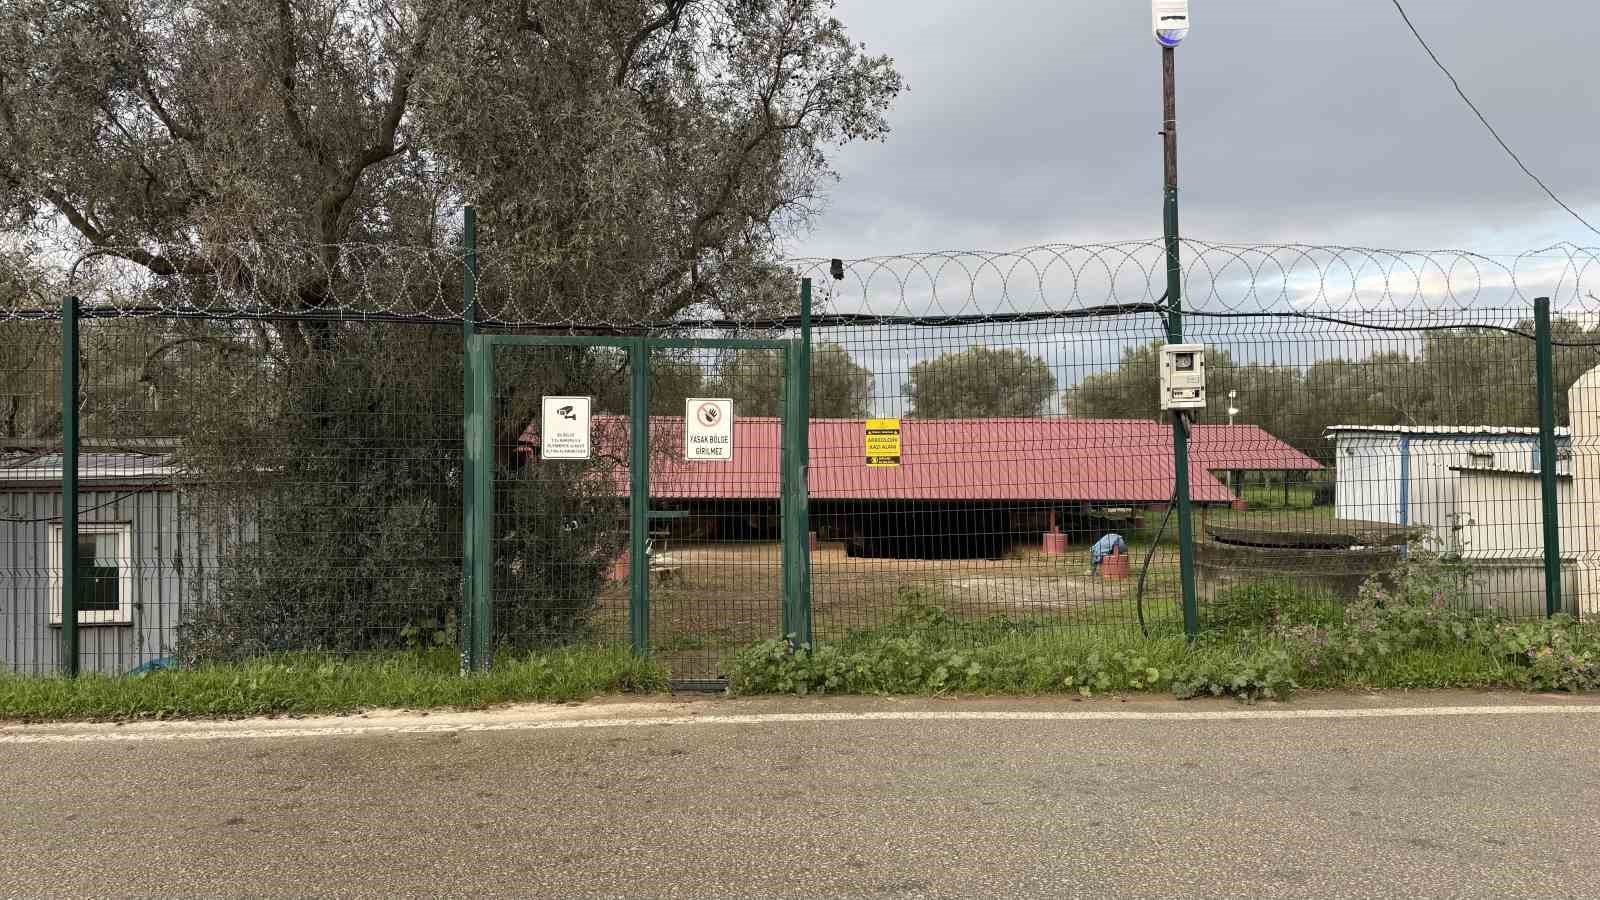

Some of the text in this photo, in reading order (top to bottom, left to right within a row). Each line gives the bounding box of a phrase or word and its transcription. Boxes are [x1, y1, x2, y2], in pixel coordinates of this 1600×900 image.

[690, 434, 728, 444] YASAK BÖLGE
[696, 446, 722, 455] GİRİLMEZ
